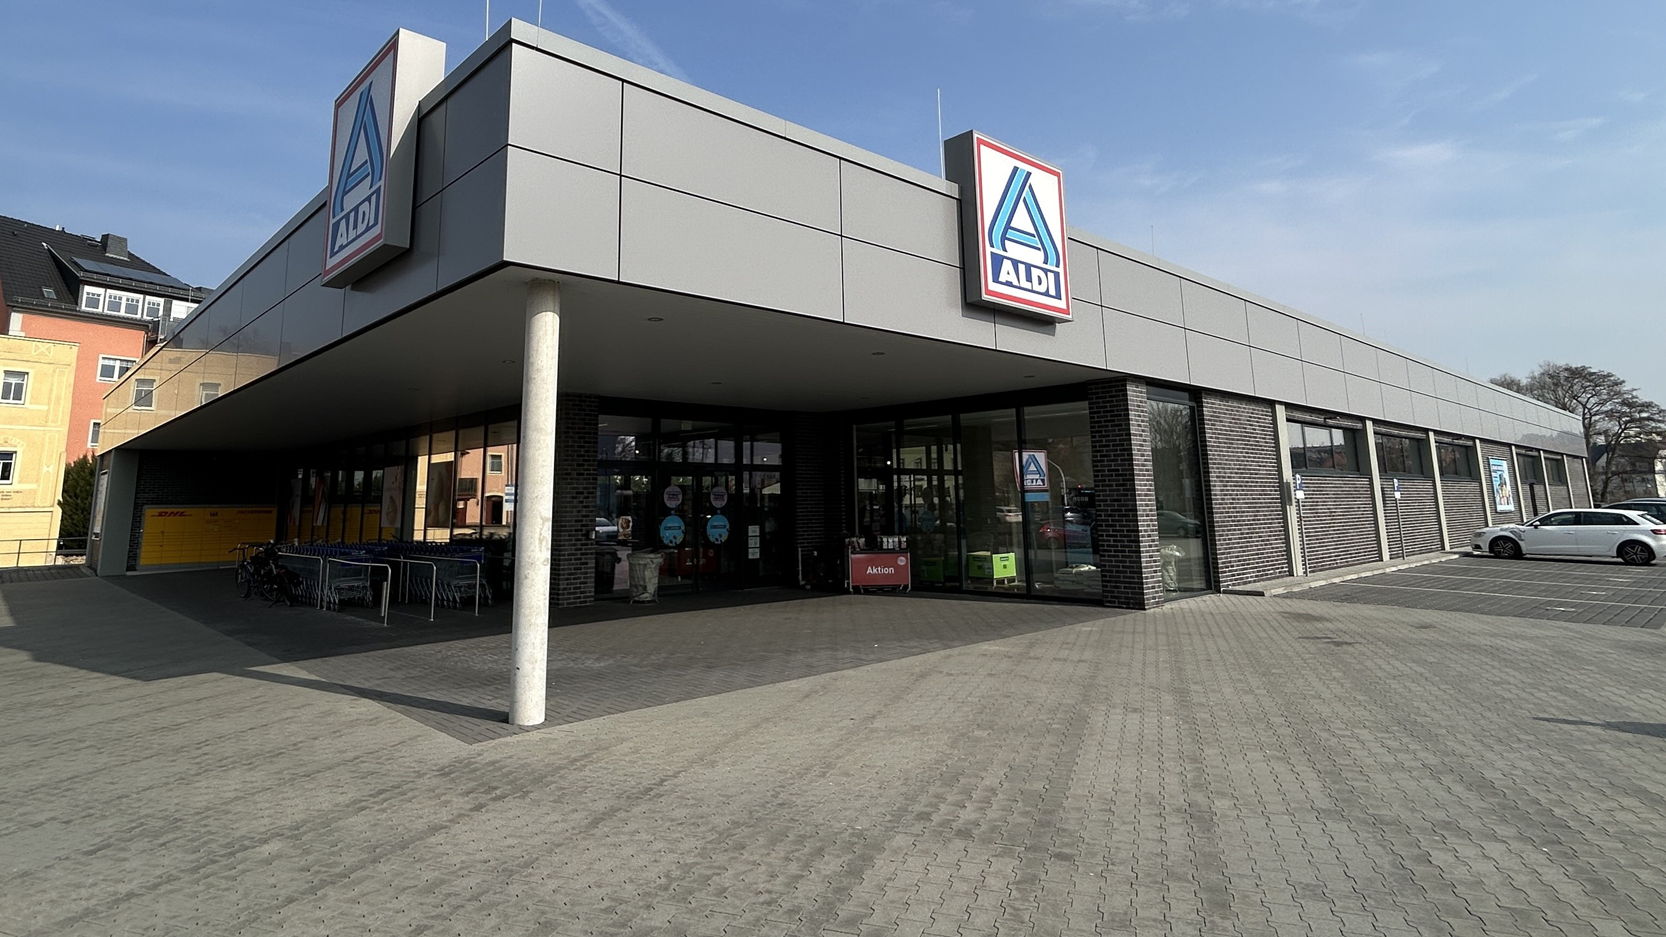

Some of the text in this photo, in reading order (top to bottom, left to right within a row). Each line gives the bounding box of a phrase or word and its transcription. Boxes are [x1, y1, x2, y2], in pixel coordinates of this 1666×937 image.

[333, 193, 377, 253] ALDI
[998, 259, 1056, 296] ALDI
[1295, 473, 1301, 489] P
[1393, 478, 1398, 490] P
[866, 565, 895, 575] Aktion
